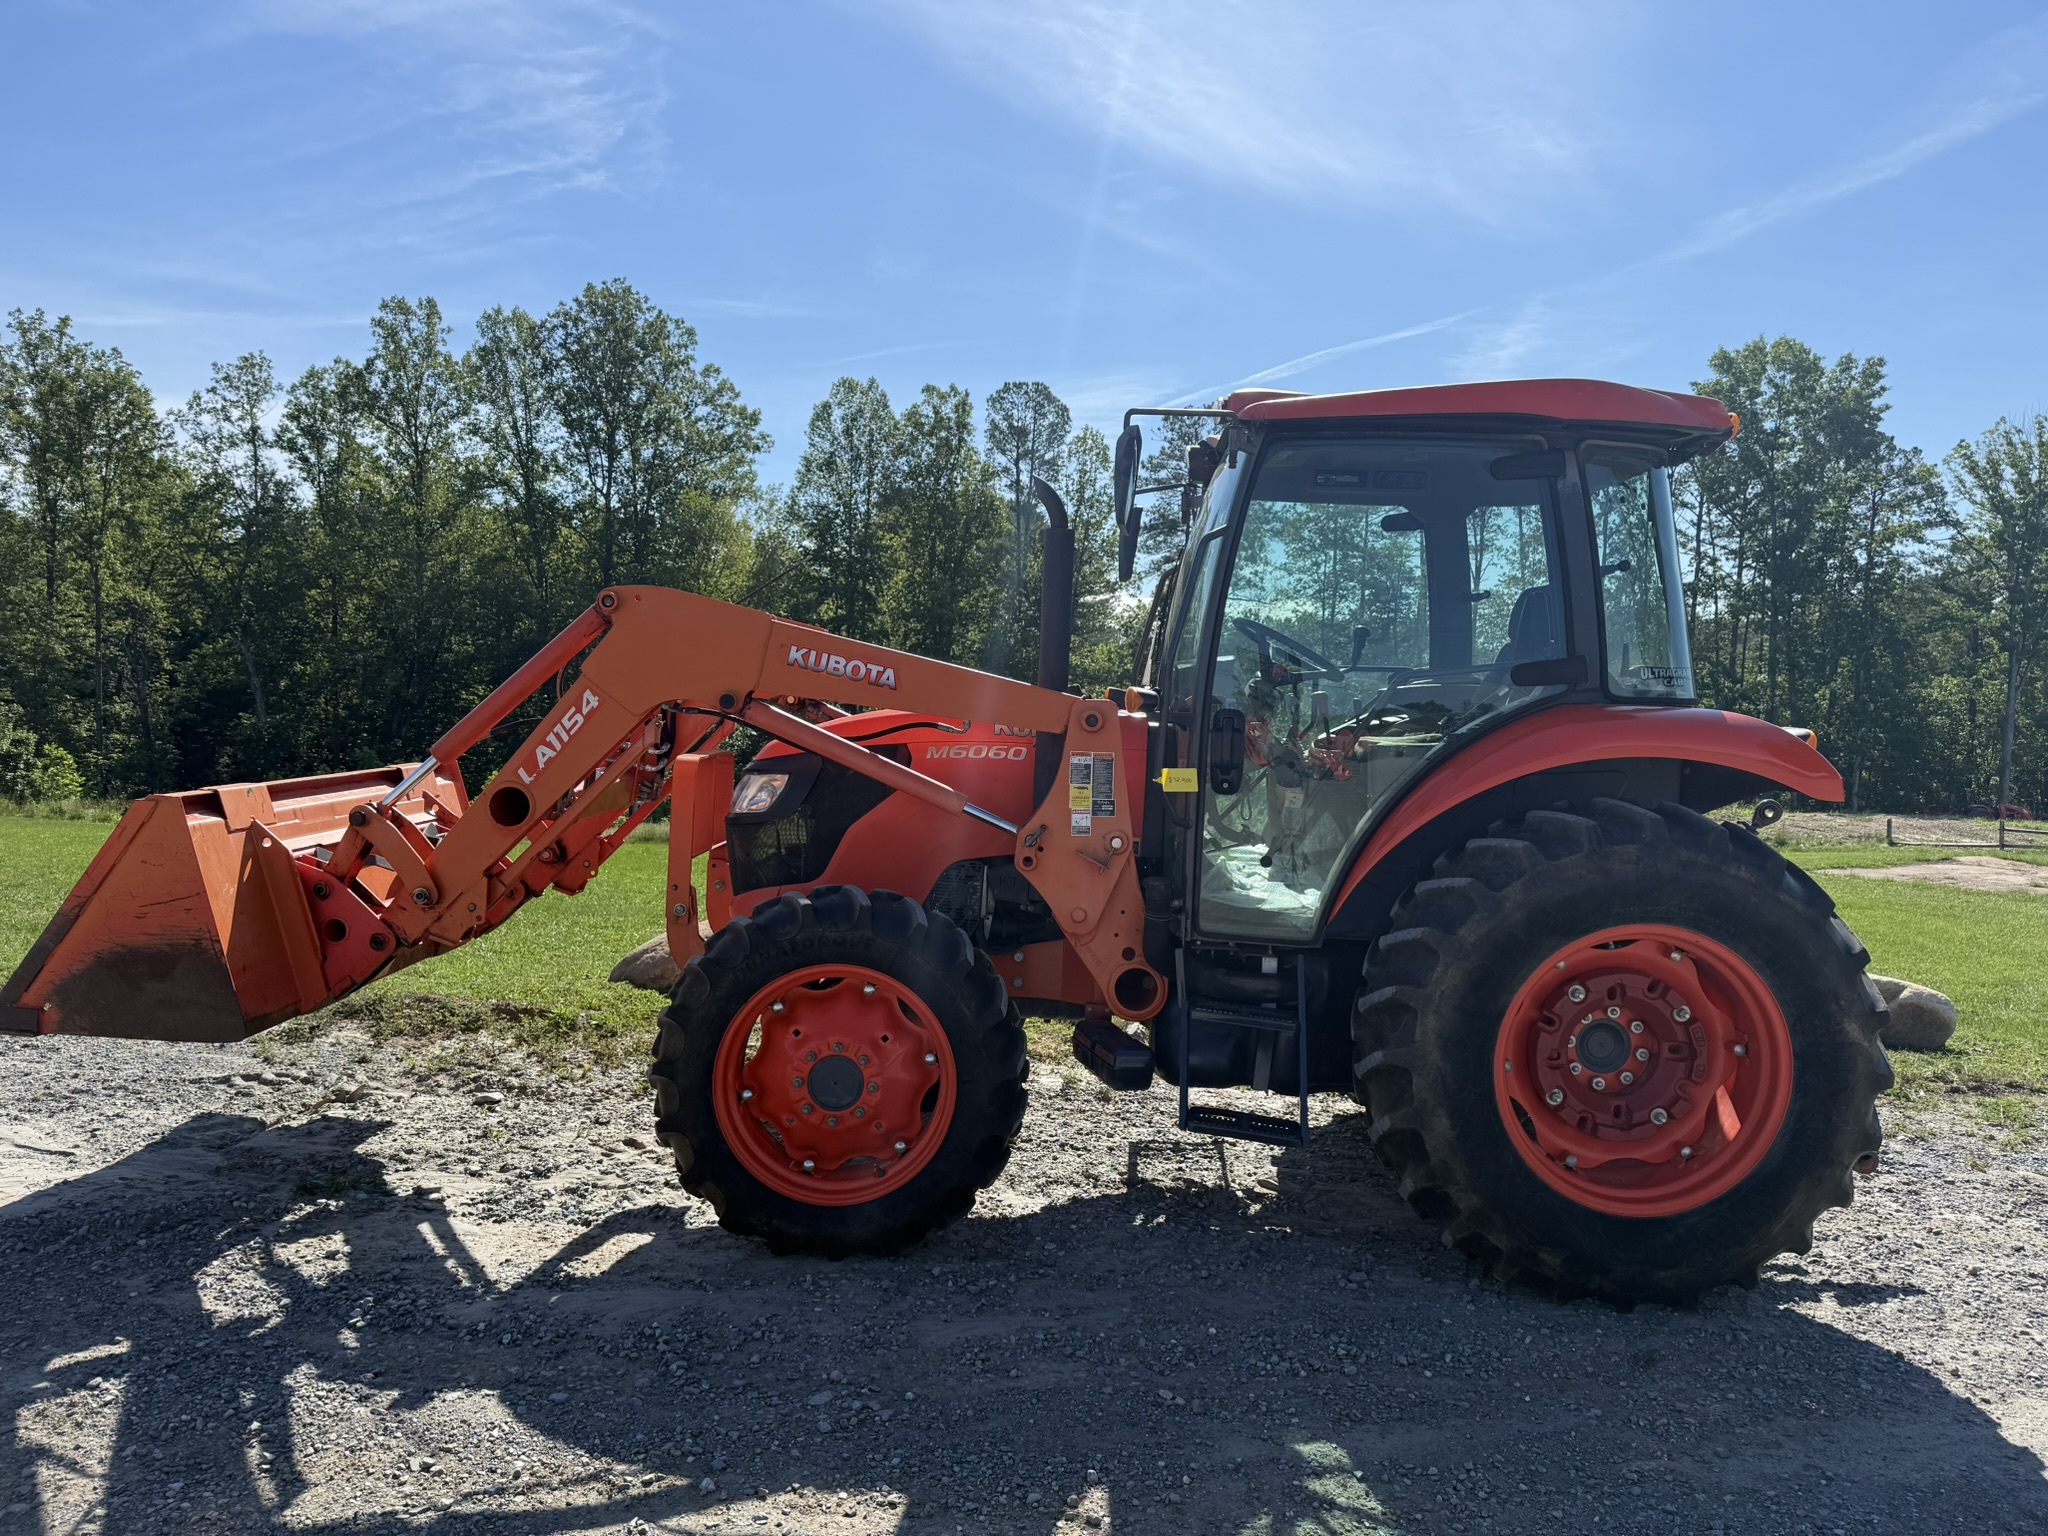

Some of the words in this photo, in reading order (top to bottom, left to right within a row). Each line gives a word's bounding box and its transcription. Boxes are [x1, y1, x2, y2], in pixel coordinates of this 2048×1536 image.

[787, 645, 897, 690] KUBOTA
[1640, 667, 1691, 680] ULTRAGRA
[1663, 679, 1684, 687] CAB
[517, 688, 600, 785] LA1154
[925, 745, 1028, 761] M6060
[1000, 876, 1017, 889] HOT
